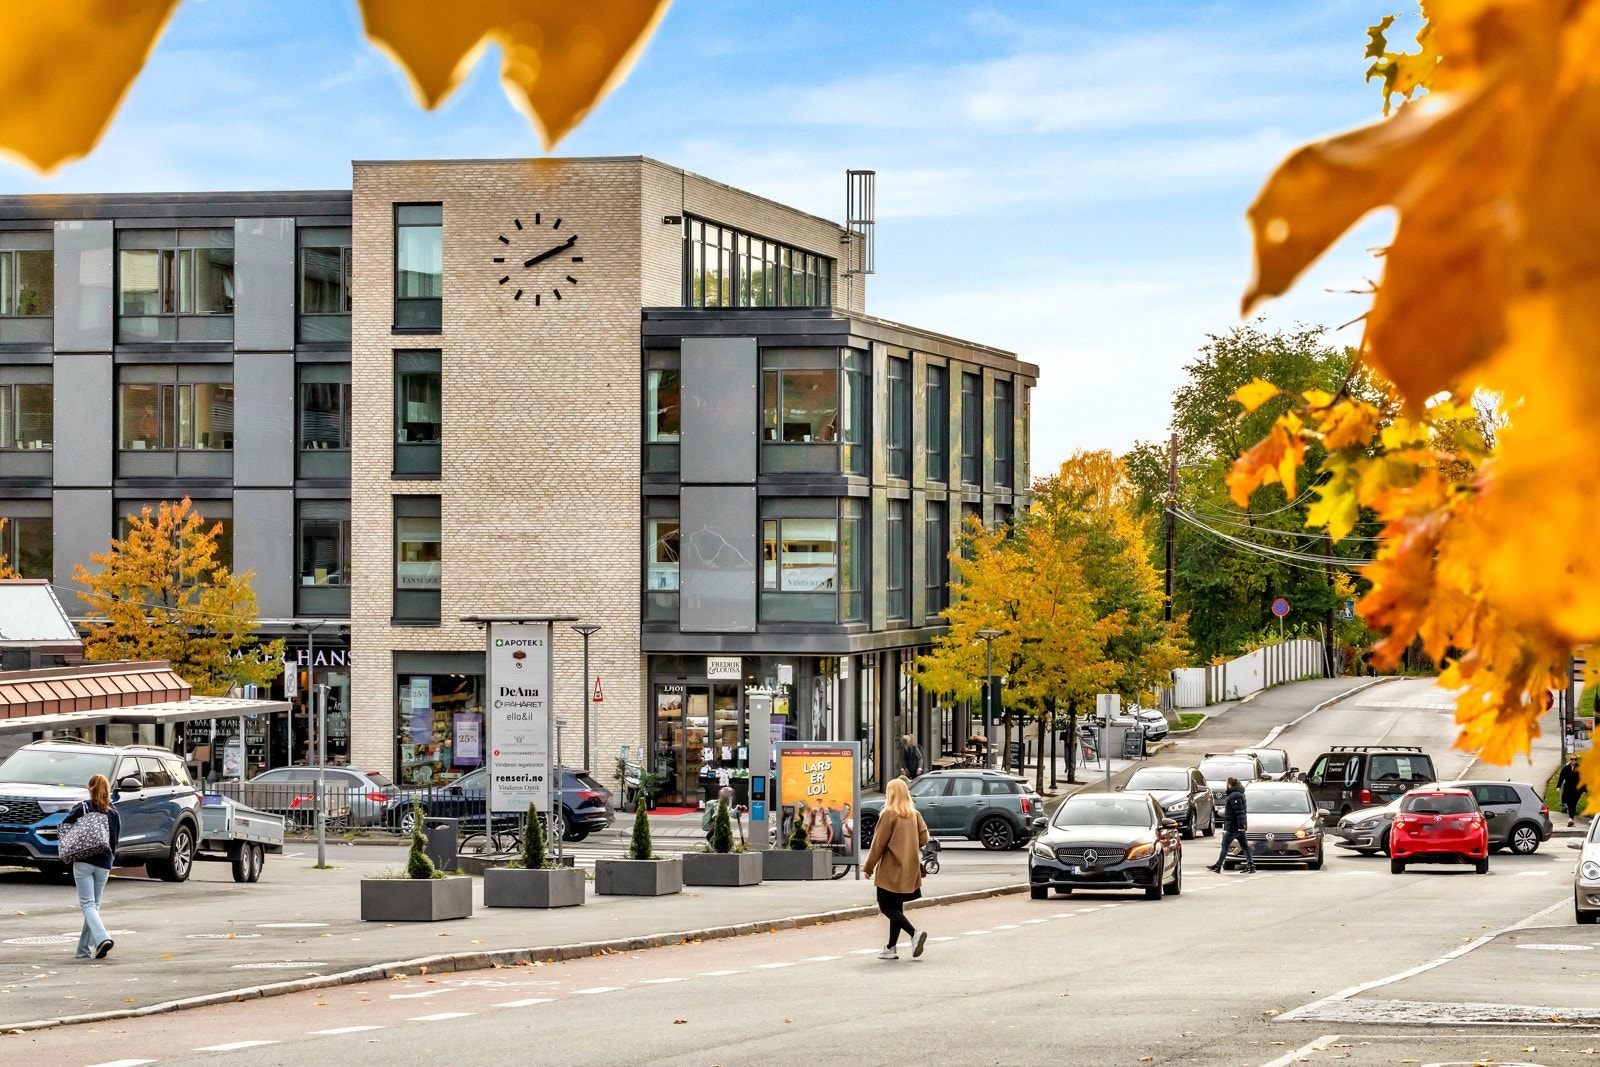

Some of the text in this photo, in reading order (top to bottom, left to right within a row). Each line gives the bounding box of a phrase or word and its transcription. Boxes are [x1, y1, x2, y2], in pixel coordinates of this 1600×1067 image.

[504, 639, 538, 647] APOTEK
[412, 690, 429, 698] 25%
[500, 686, 539, 697] DeAna
[458, 734, 477, 743] 25%
[803, 760, 832, 774] LARS
[496, 773, 543, 782] renseri.no
[810, 773, 825, 785] ER
[524, 784, 540, 792] Optik
[807, 784, 828, 796] LOL
